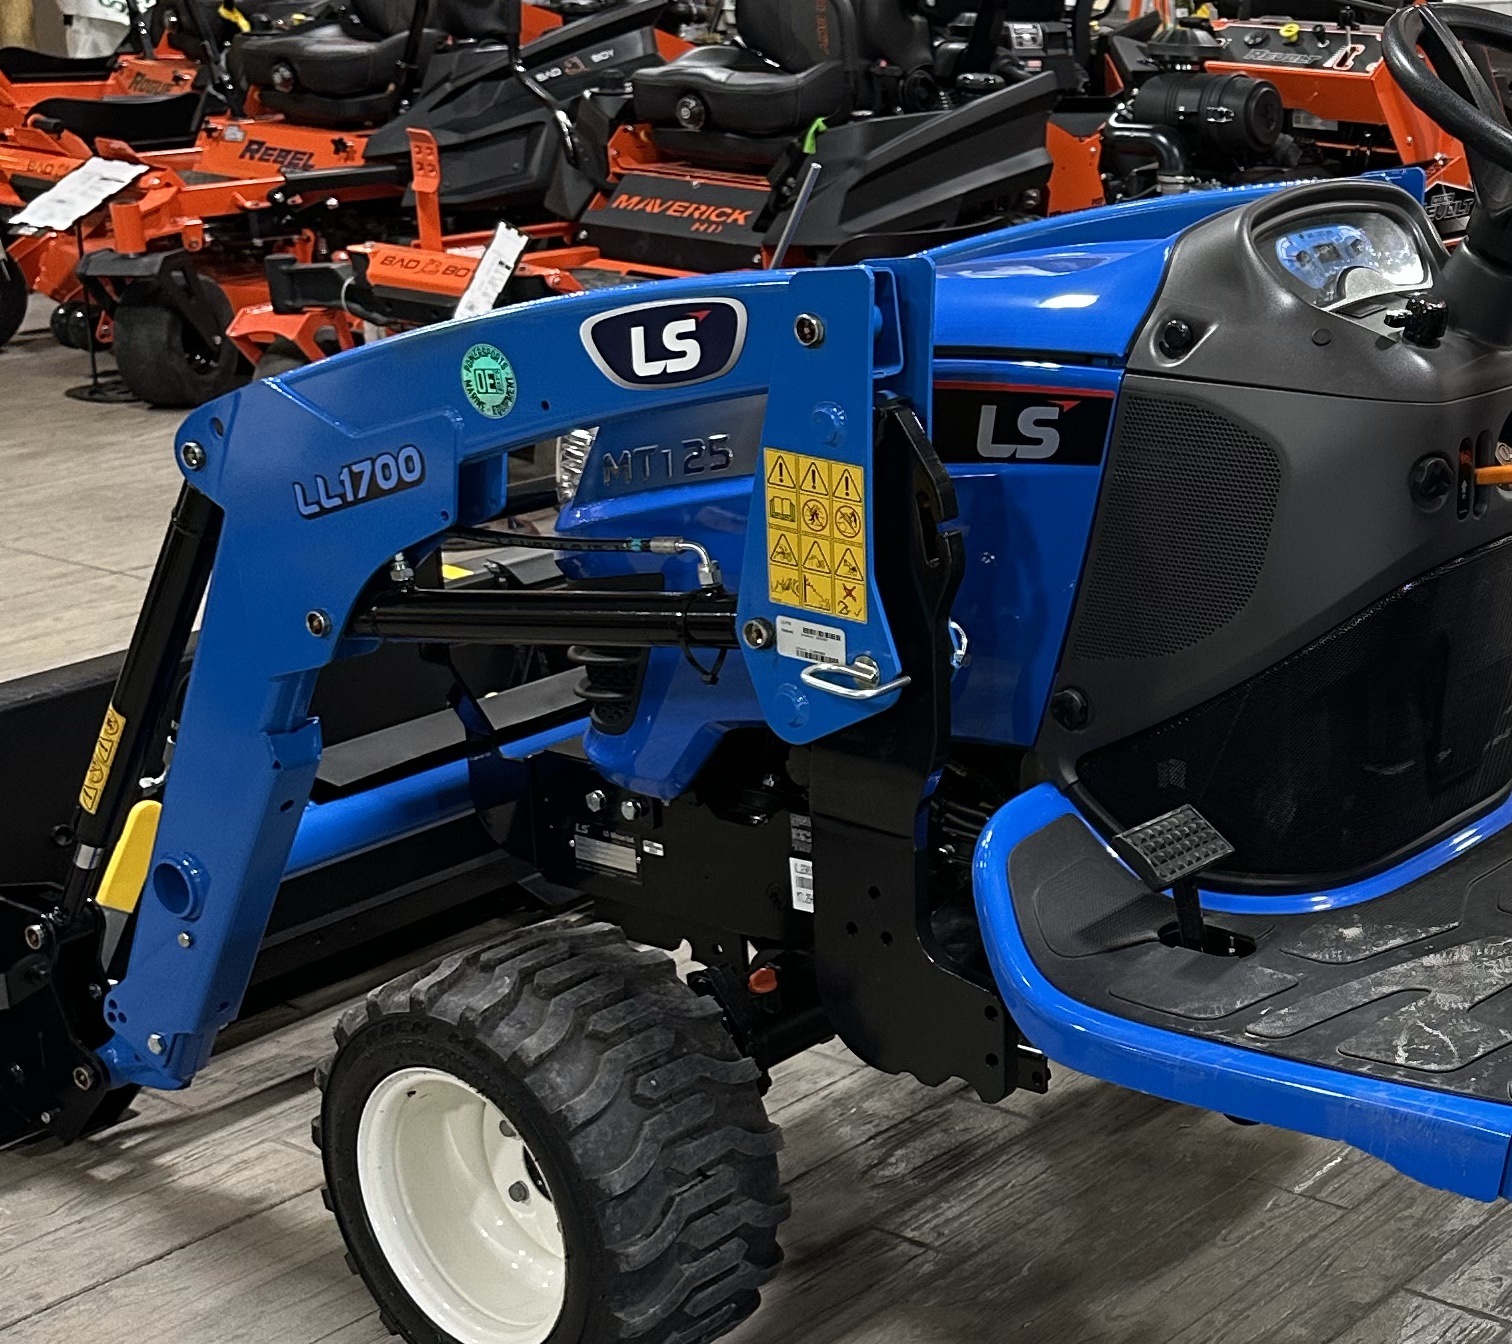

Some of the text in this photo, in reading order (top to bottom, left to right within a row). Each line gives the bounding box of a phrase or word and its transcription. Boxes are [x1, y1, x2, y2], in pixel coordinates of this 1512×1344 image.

[239, 139, 315, 171] REBEL
[611, 194, 753, 225] MAVERICK
[381, 255, 476, 277] BAD BO
[631, 318, 701, 376] LS
[976, 405, 1060, 460] LS
[293, 445, 423, 517] LL1700
